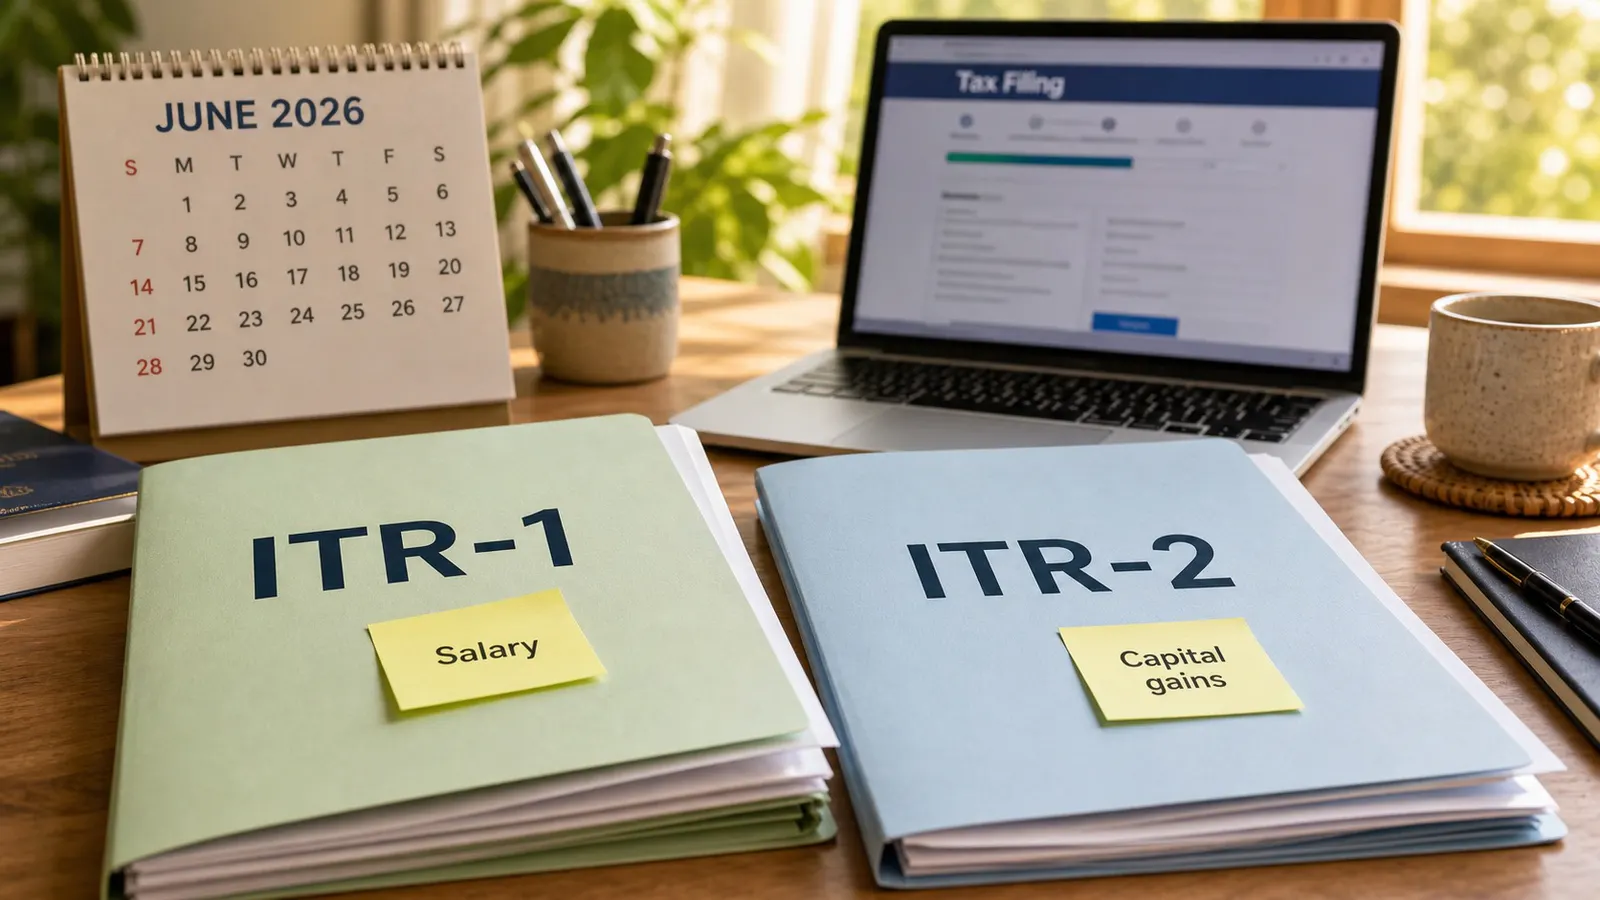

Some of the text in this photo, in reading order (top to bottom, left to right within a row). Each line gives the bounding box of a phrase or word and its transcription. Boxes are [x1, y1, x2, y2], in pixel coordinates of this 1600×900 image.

[955, 69, 1066, 100] Tax Filing
[155, 96, 365, 133] JUNE 2026
[124, 145, 446, 177] S M T W T F S
[181, 183, 449, 214] 1 2 3 4 5 6
[131, 220, 457, 257] 7 8 9 10 11 12 13
[129, 257, 462, 297] 14 15 16 17 18 19 20
[133, 295, 465, 337] 21 22 23 24 25 26 27
[136, 348, 268, 377] 28 29 30
[252, 508, 575, 600] ITR-1
[906, 534, 1236, 599] ITR-2
[435, 639, 539, 665] Salary
[1120, 645, 1226, 670] Capital
[1145, 672, 1227, 696] gains
